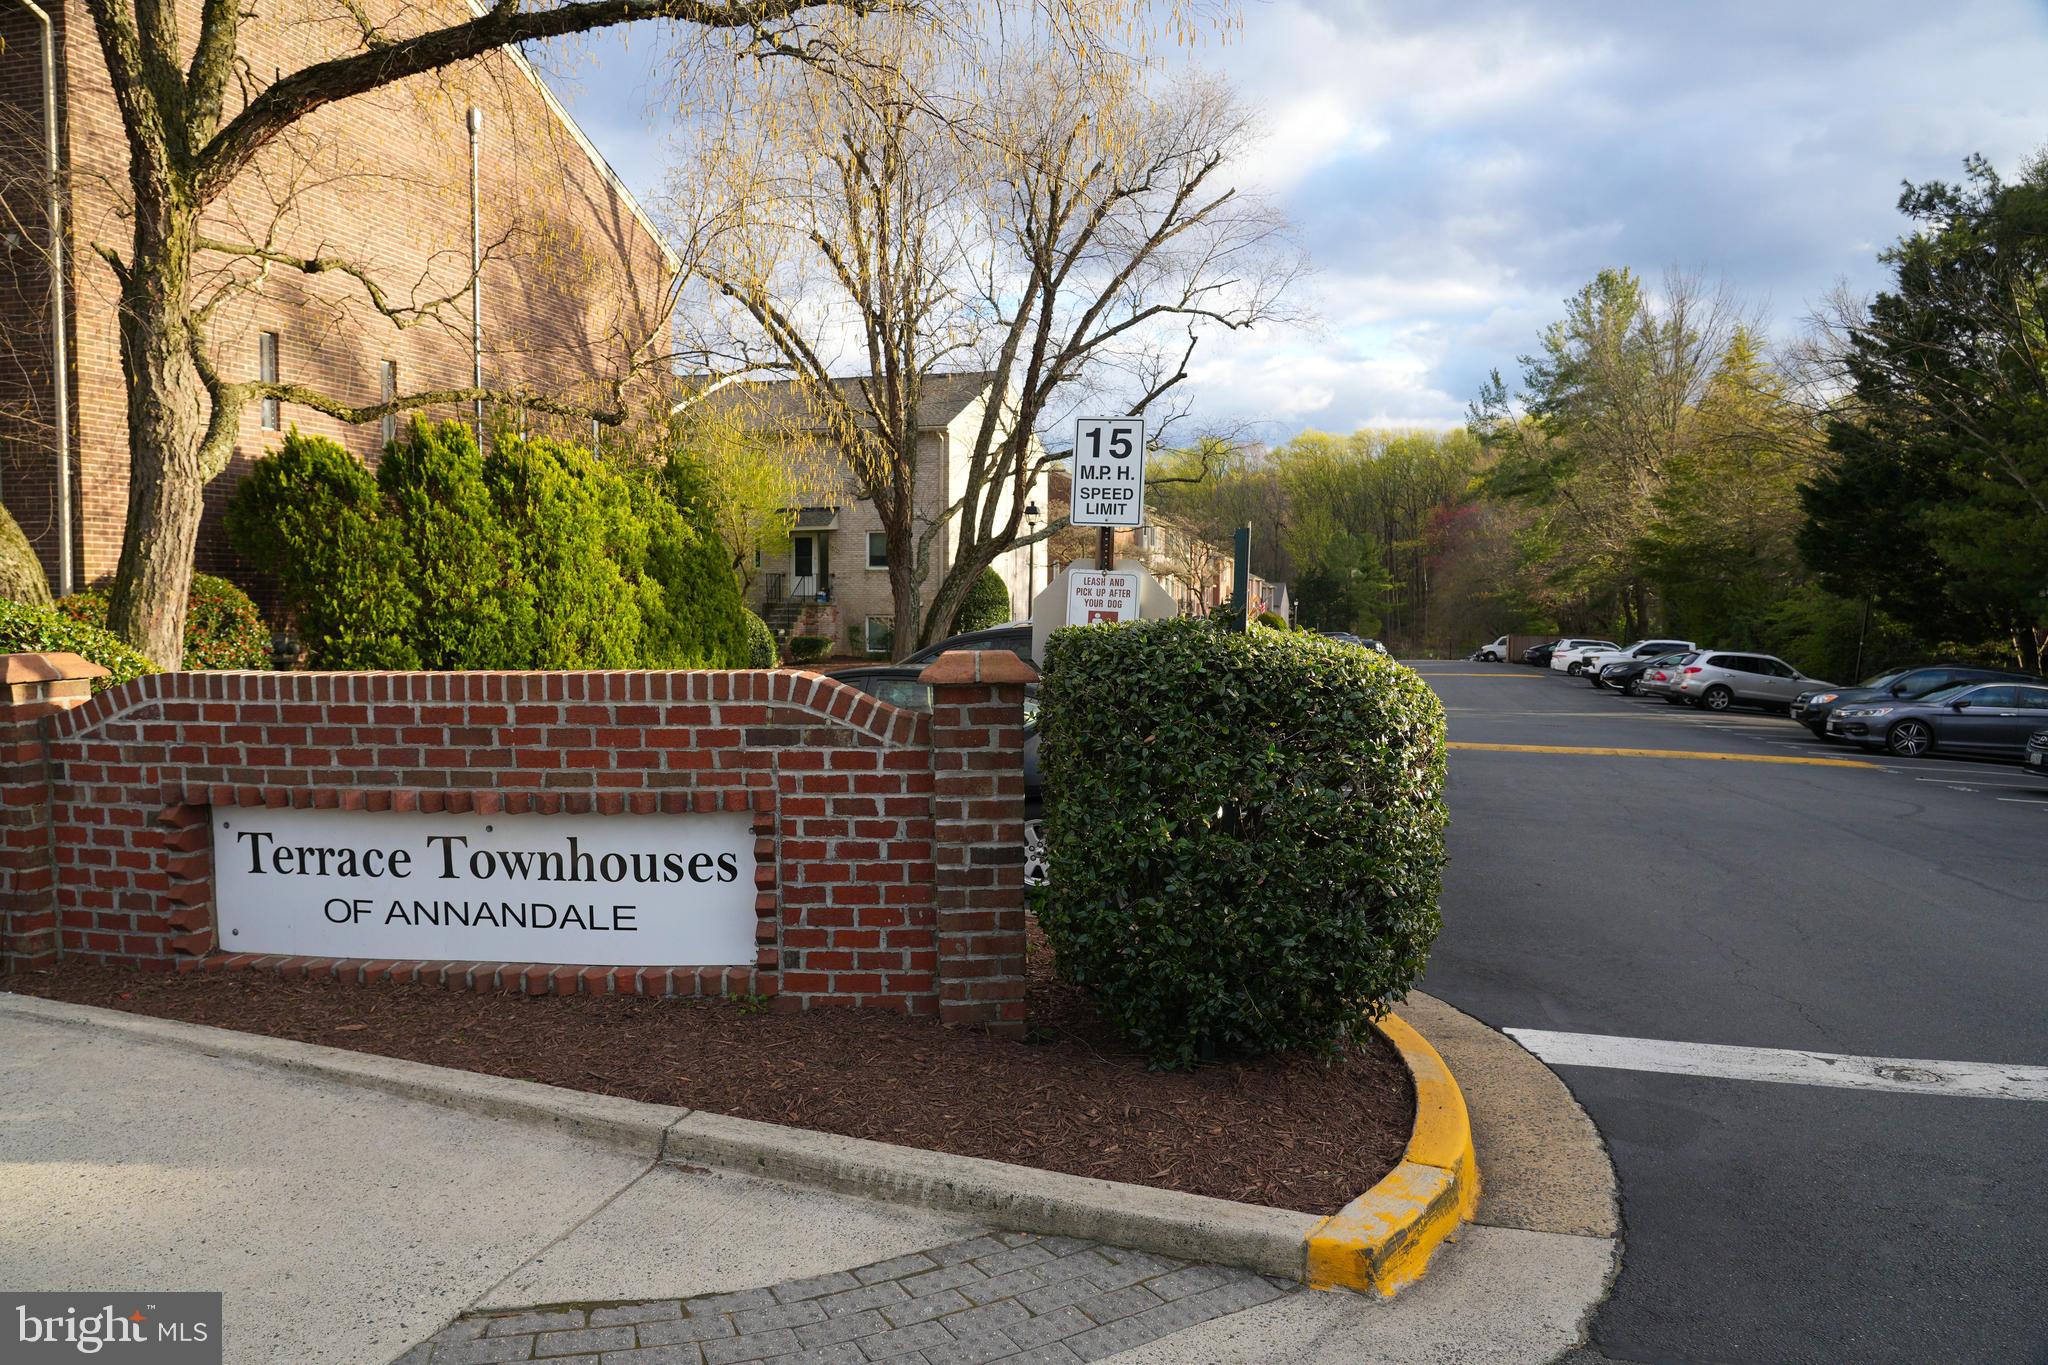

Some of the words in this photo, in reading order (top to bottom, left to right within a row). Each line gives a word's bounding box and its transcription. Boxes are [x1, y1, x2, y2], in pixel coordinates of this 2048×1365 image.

[1086, 427, 1133, 459] 15
[1080, 487, 1134, 500] SPEED
[1086, 503, 1127, 515] LIMIT
[1083, 577, 1106, 586] LEASH
[1109, 578, 1125, 587] AND
[1076, 588, 1094, 597] PICK
[1096, 588, 1106, 597] UP
[1109, 589, 1131, 597] AFTER
[1084, 599, 1105, 608] YOUR
[1107, 600, 1122, 608] DOG
[237, 831, 412, 878] Terrace
[427, 835, 739, 883] Townhouses
[324, 898, 374, 924] OF
[384, 900, 638, 931] ANNANDALE
